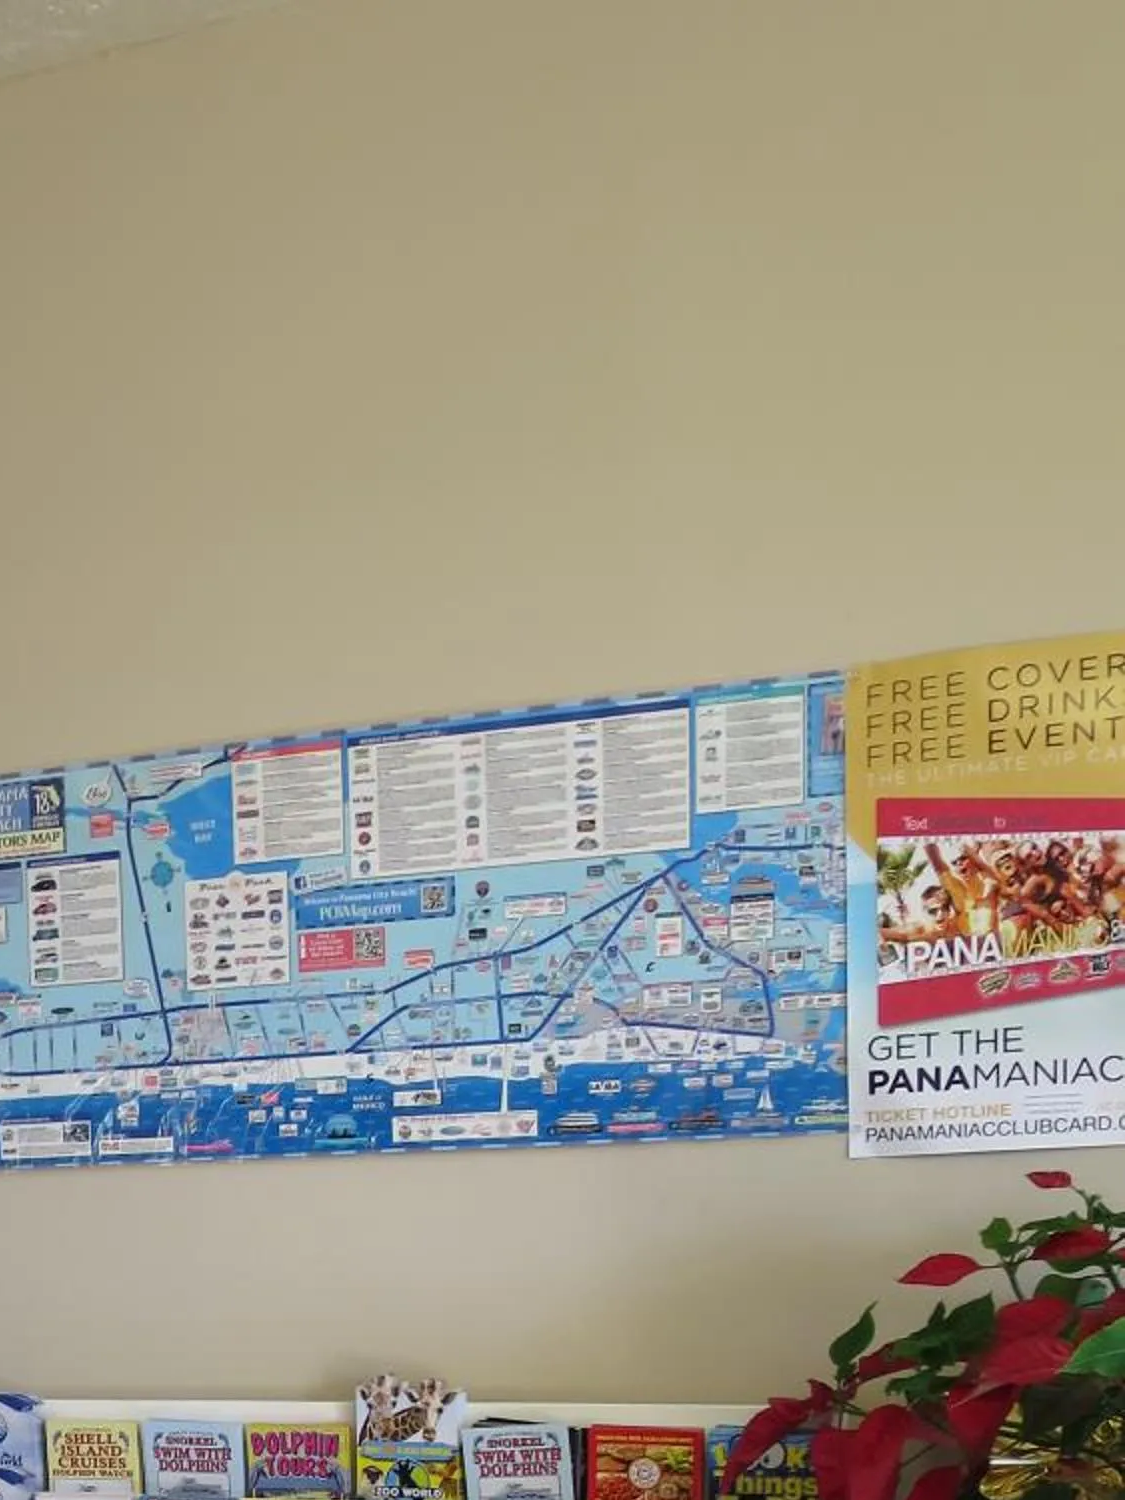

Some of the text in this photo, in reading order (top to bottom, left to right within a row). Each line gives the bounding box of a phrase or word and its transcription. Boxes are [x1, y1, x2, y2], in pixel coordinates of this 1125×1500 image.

[866, 652, 1125, 708] FREE COVER
[866, 685, 1125, 739] FREE DRINK
[866, 734, 966, 768] FREE
[903, 816, 1006, 830] Text to
[868, 1026, 1024, 1061] GET THE
[868, 1055, 1125, 1095] PANAMANIAC
[867, 1108, 927, 1124] TICKET
[933, 1103, 1012, 1120] HOTLINE
[64, 1433, 117, 1445] SHELL
[250, 1431, 340, 1459] DOLPHIN
[60, 1445, 122, 1456] ISLAND
[155, 1447, 193, 1461] SWIM
[474, 1448, 561, 1464] SWIM WITH
[57, 1457, 126, 1470] CRUISES
[158, 1459, 228, 1473] DOLPHINS
[264, 1456, 330, 1480] TOURS
[480, 1462, 559, 1477] DOLPHINS
[376, 1487, 444, 1499] ZOO WORLD
